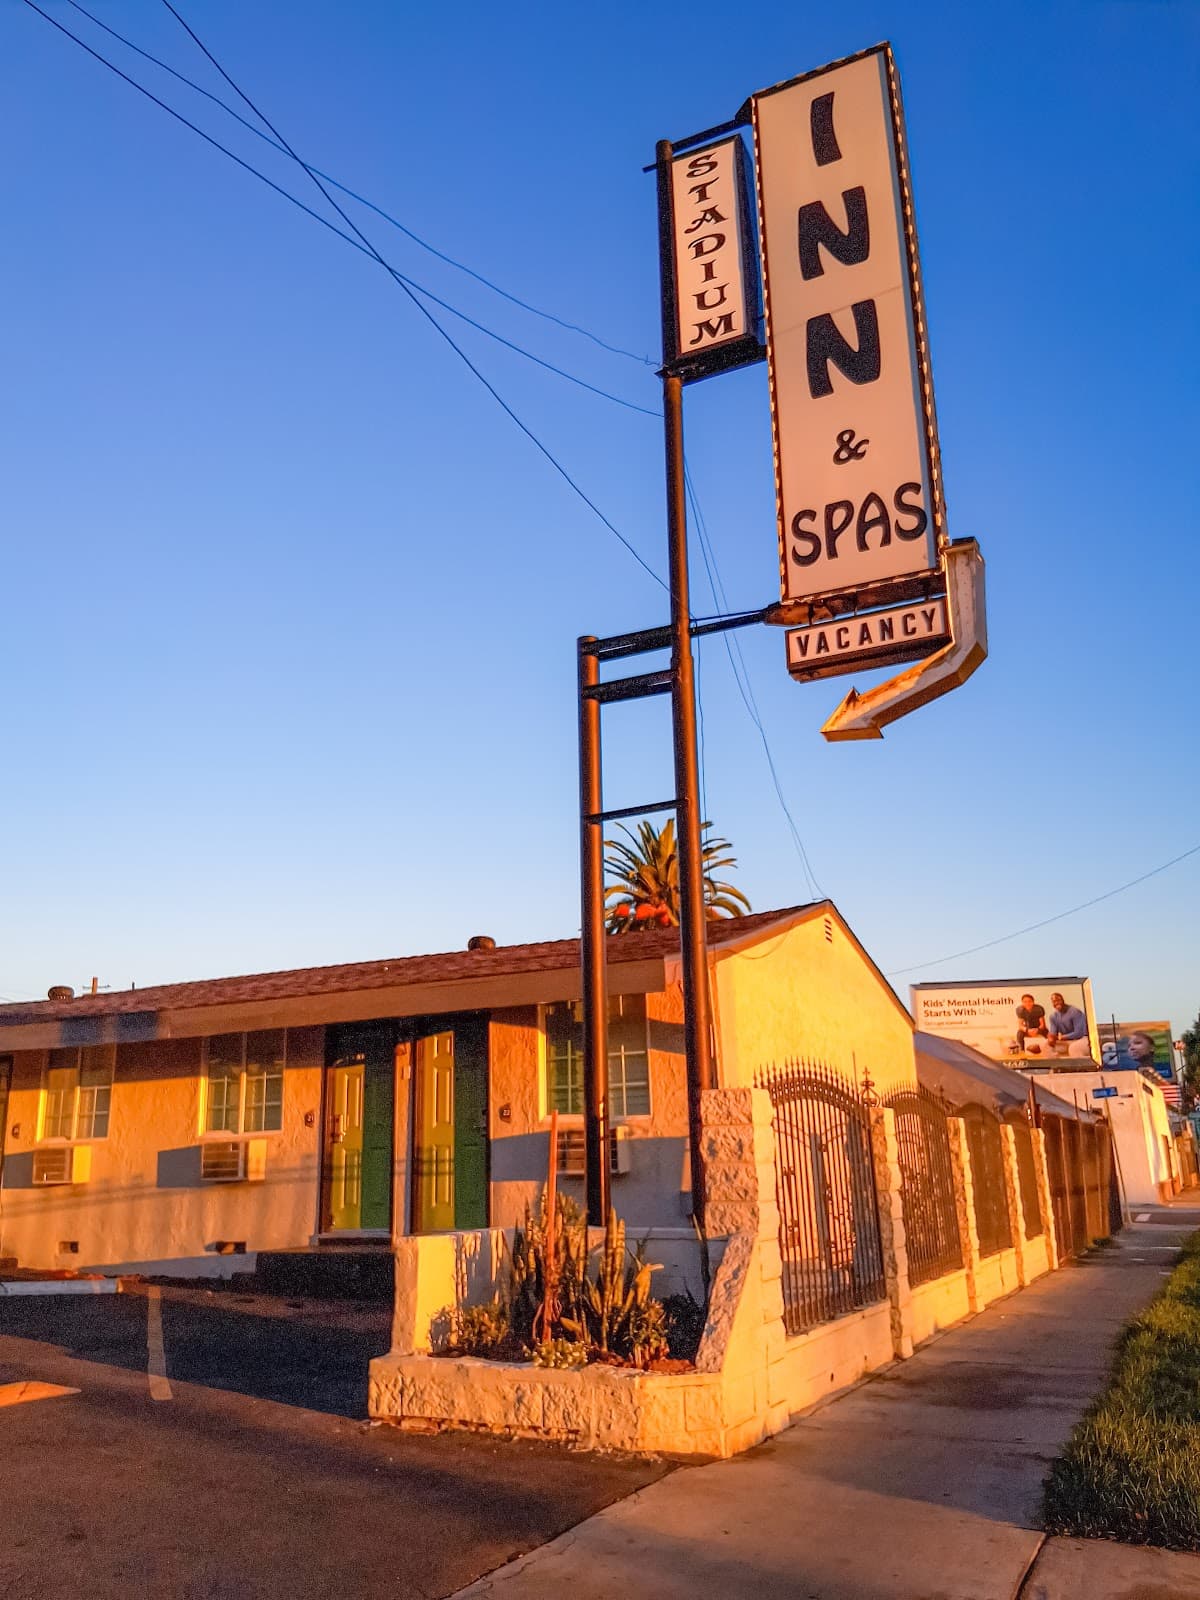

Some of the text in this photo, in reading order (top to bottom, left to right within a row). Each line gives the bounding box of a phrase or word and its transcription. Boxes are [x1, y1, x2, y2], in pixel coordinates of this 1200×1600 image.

[684, 152, 738, 346] STADIUM
[798, 91, 881, 399] INN
[833, 429, 869, 465] &
[791, 482, 928, 567] SPAS
[796, 607, 936, 657] VACANCY
[923, 1008, 951, 1018] Starts
[953, 1007, 977, 1017] With
[947, 997, 980, 1007] Mental
[982, 996, 1014, 1006] Health
